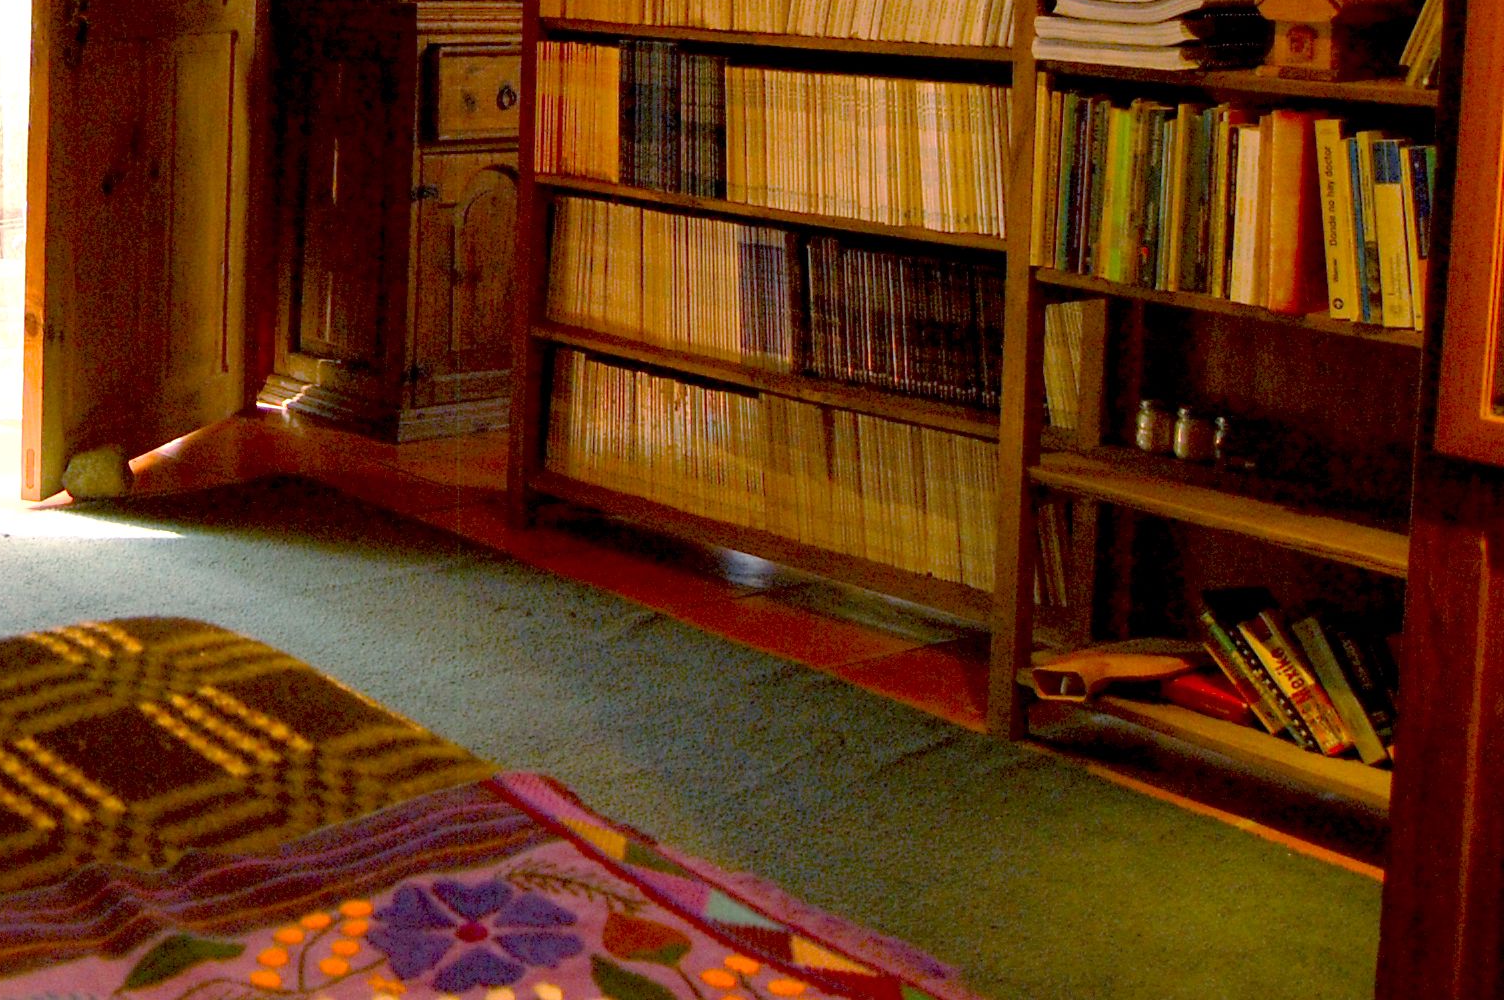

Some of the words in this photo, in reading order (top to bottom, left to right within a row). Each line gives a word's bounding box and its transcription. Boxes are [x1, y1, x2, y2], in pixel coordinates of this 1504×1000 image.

[1324, 146, 1334, 177] doctor
[1328, 199, 1335, 212] no
[1270, 647, 1310, 704] Mexiko
